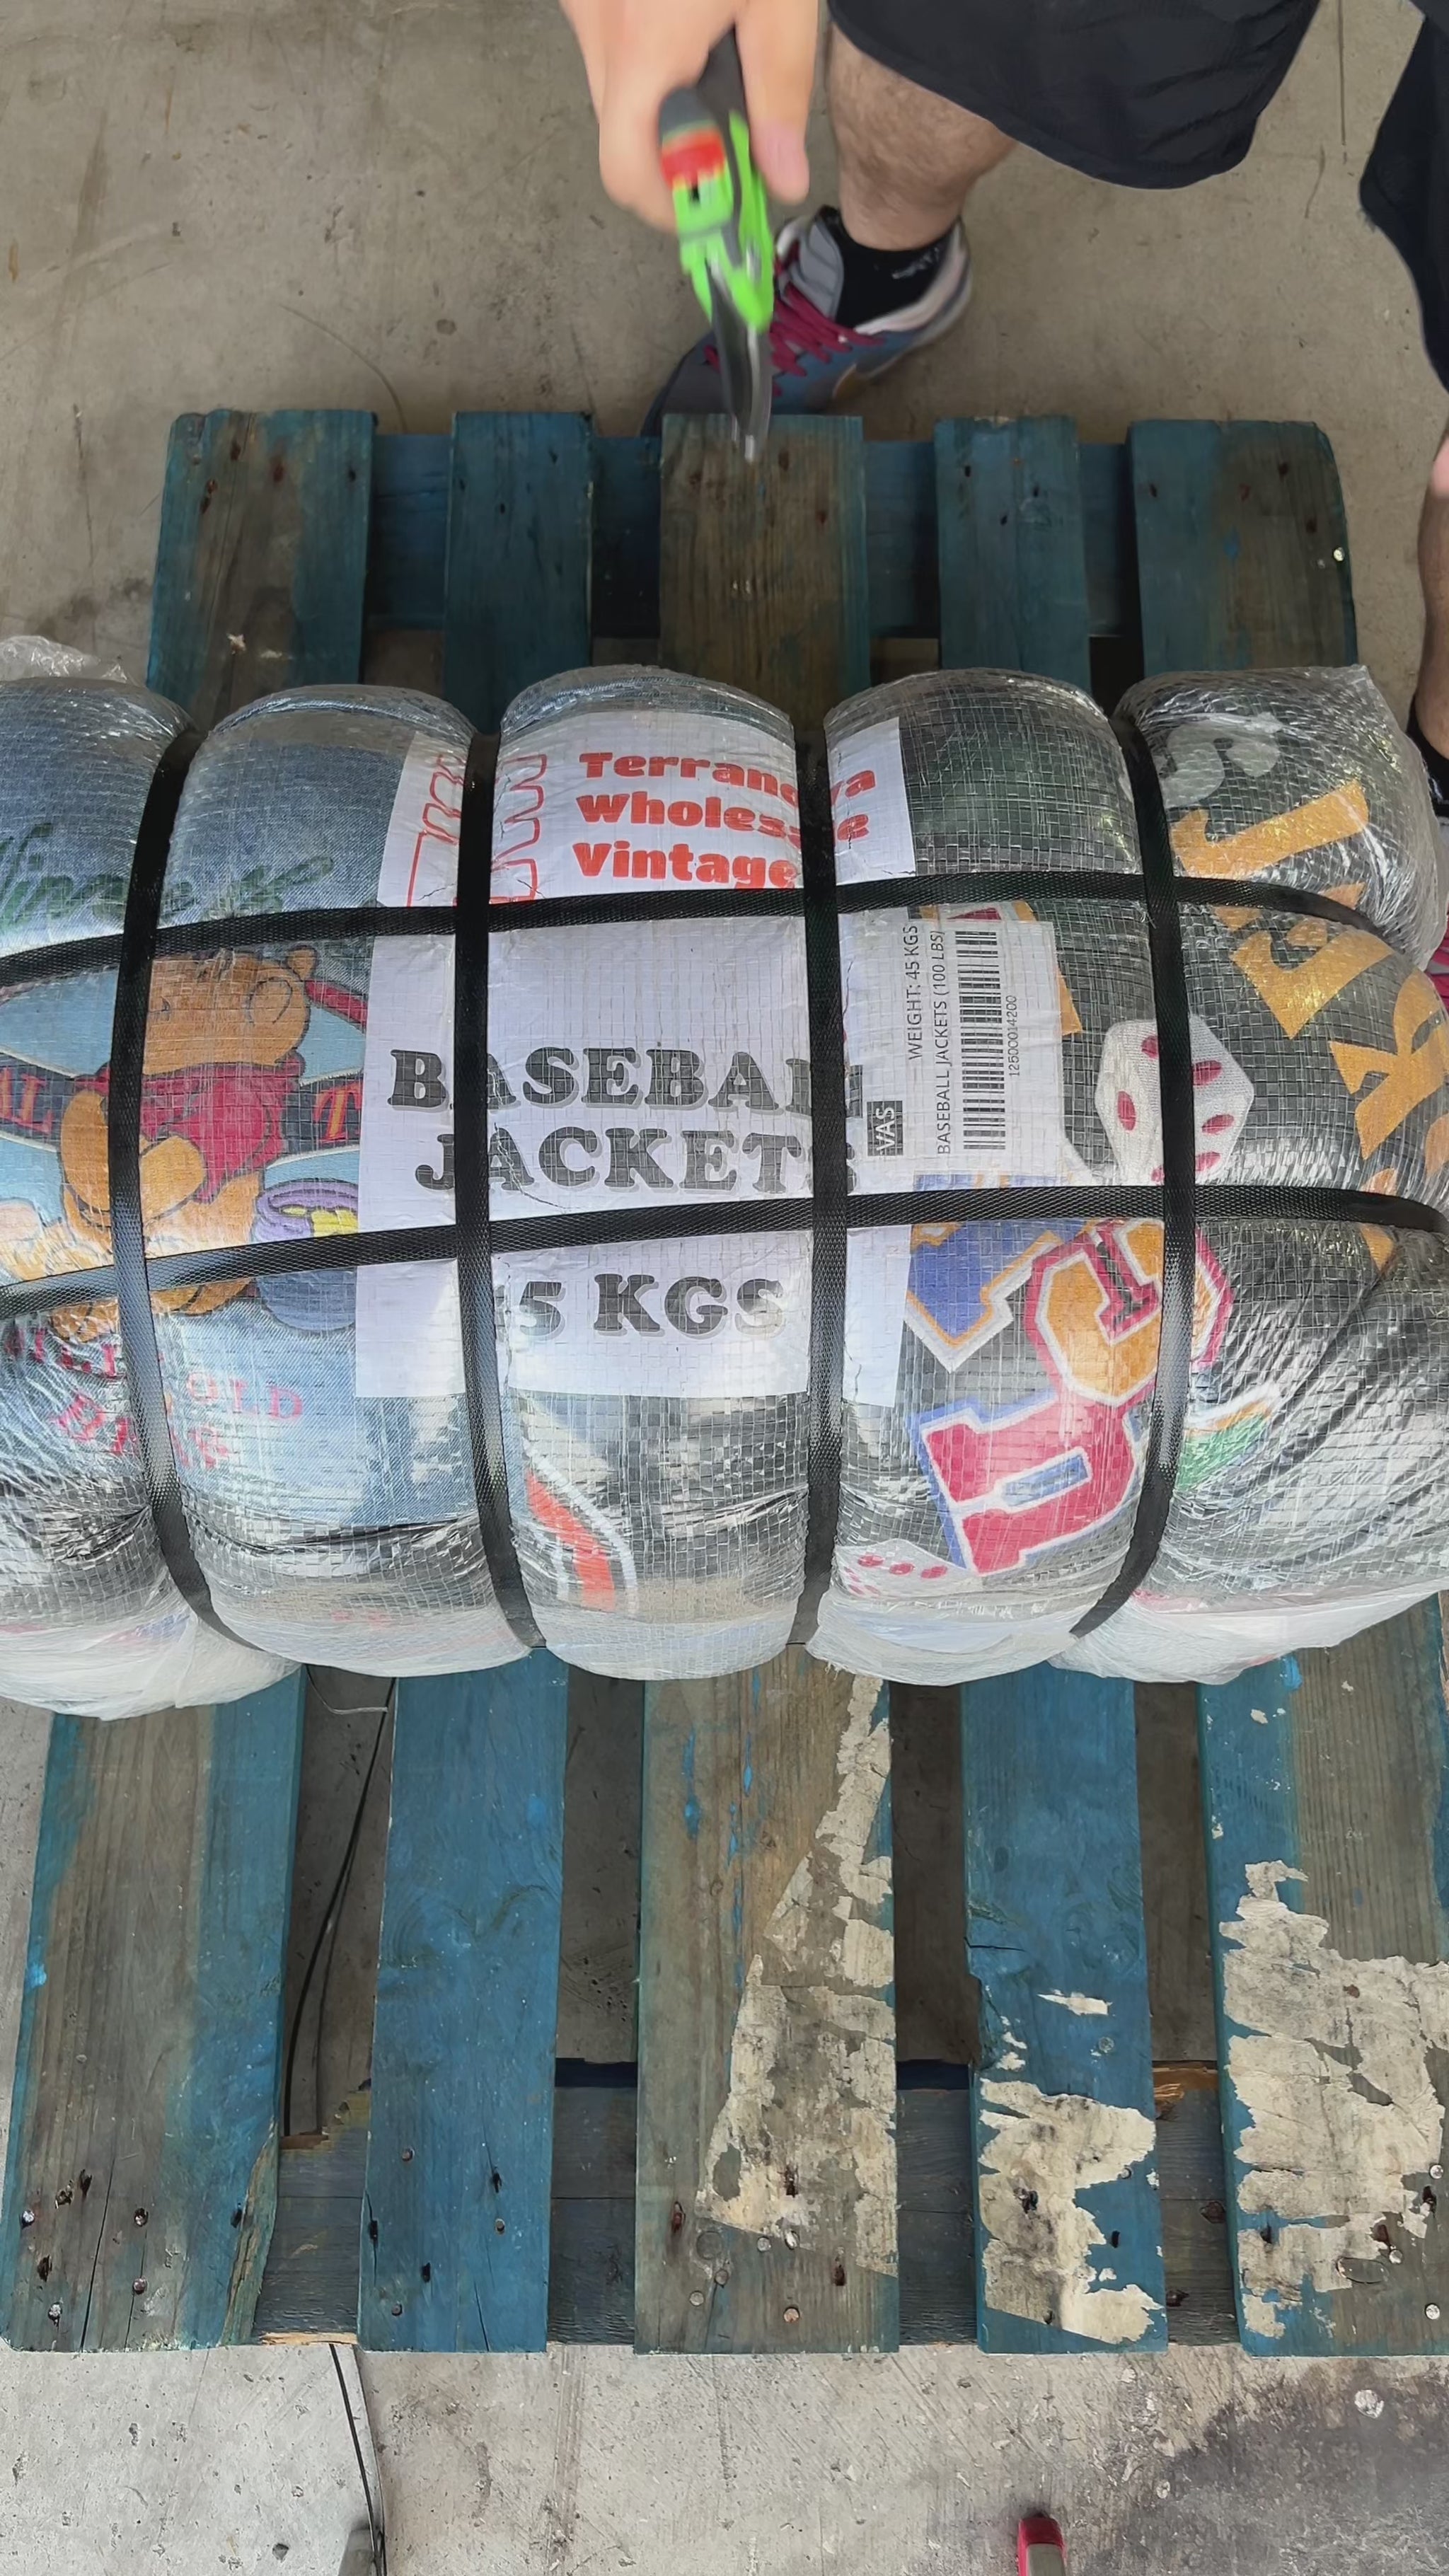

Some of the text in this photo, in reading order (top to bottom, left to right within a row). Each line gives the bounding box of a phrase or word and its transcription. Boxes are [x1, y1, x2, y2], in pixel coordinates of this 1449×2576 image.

[576, 792, 869, 849] Wholese
[573, 841, 797, 889] Vintage
[903, 925, 923, 1060] WEIGHT: 45 KGS
[930, 931, 952, 1154] BASEBALL JACKETS (100 LBS)
[1005, 995, 1020, 1076] 12500014200
[388, 1046, 862, 1118] BSEBA
[876, 1107, 895, 1151] VAS
[594, 1273, 788, 1337] KGS
